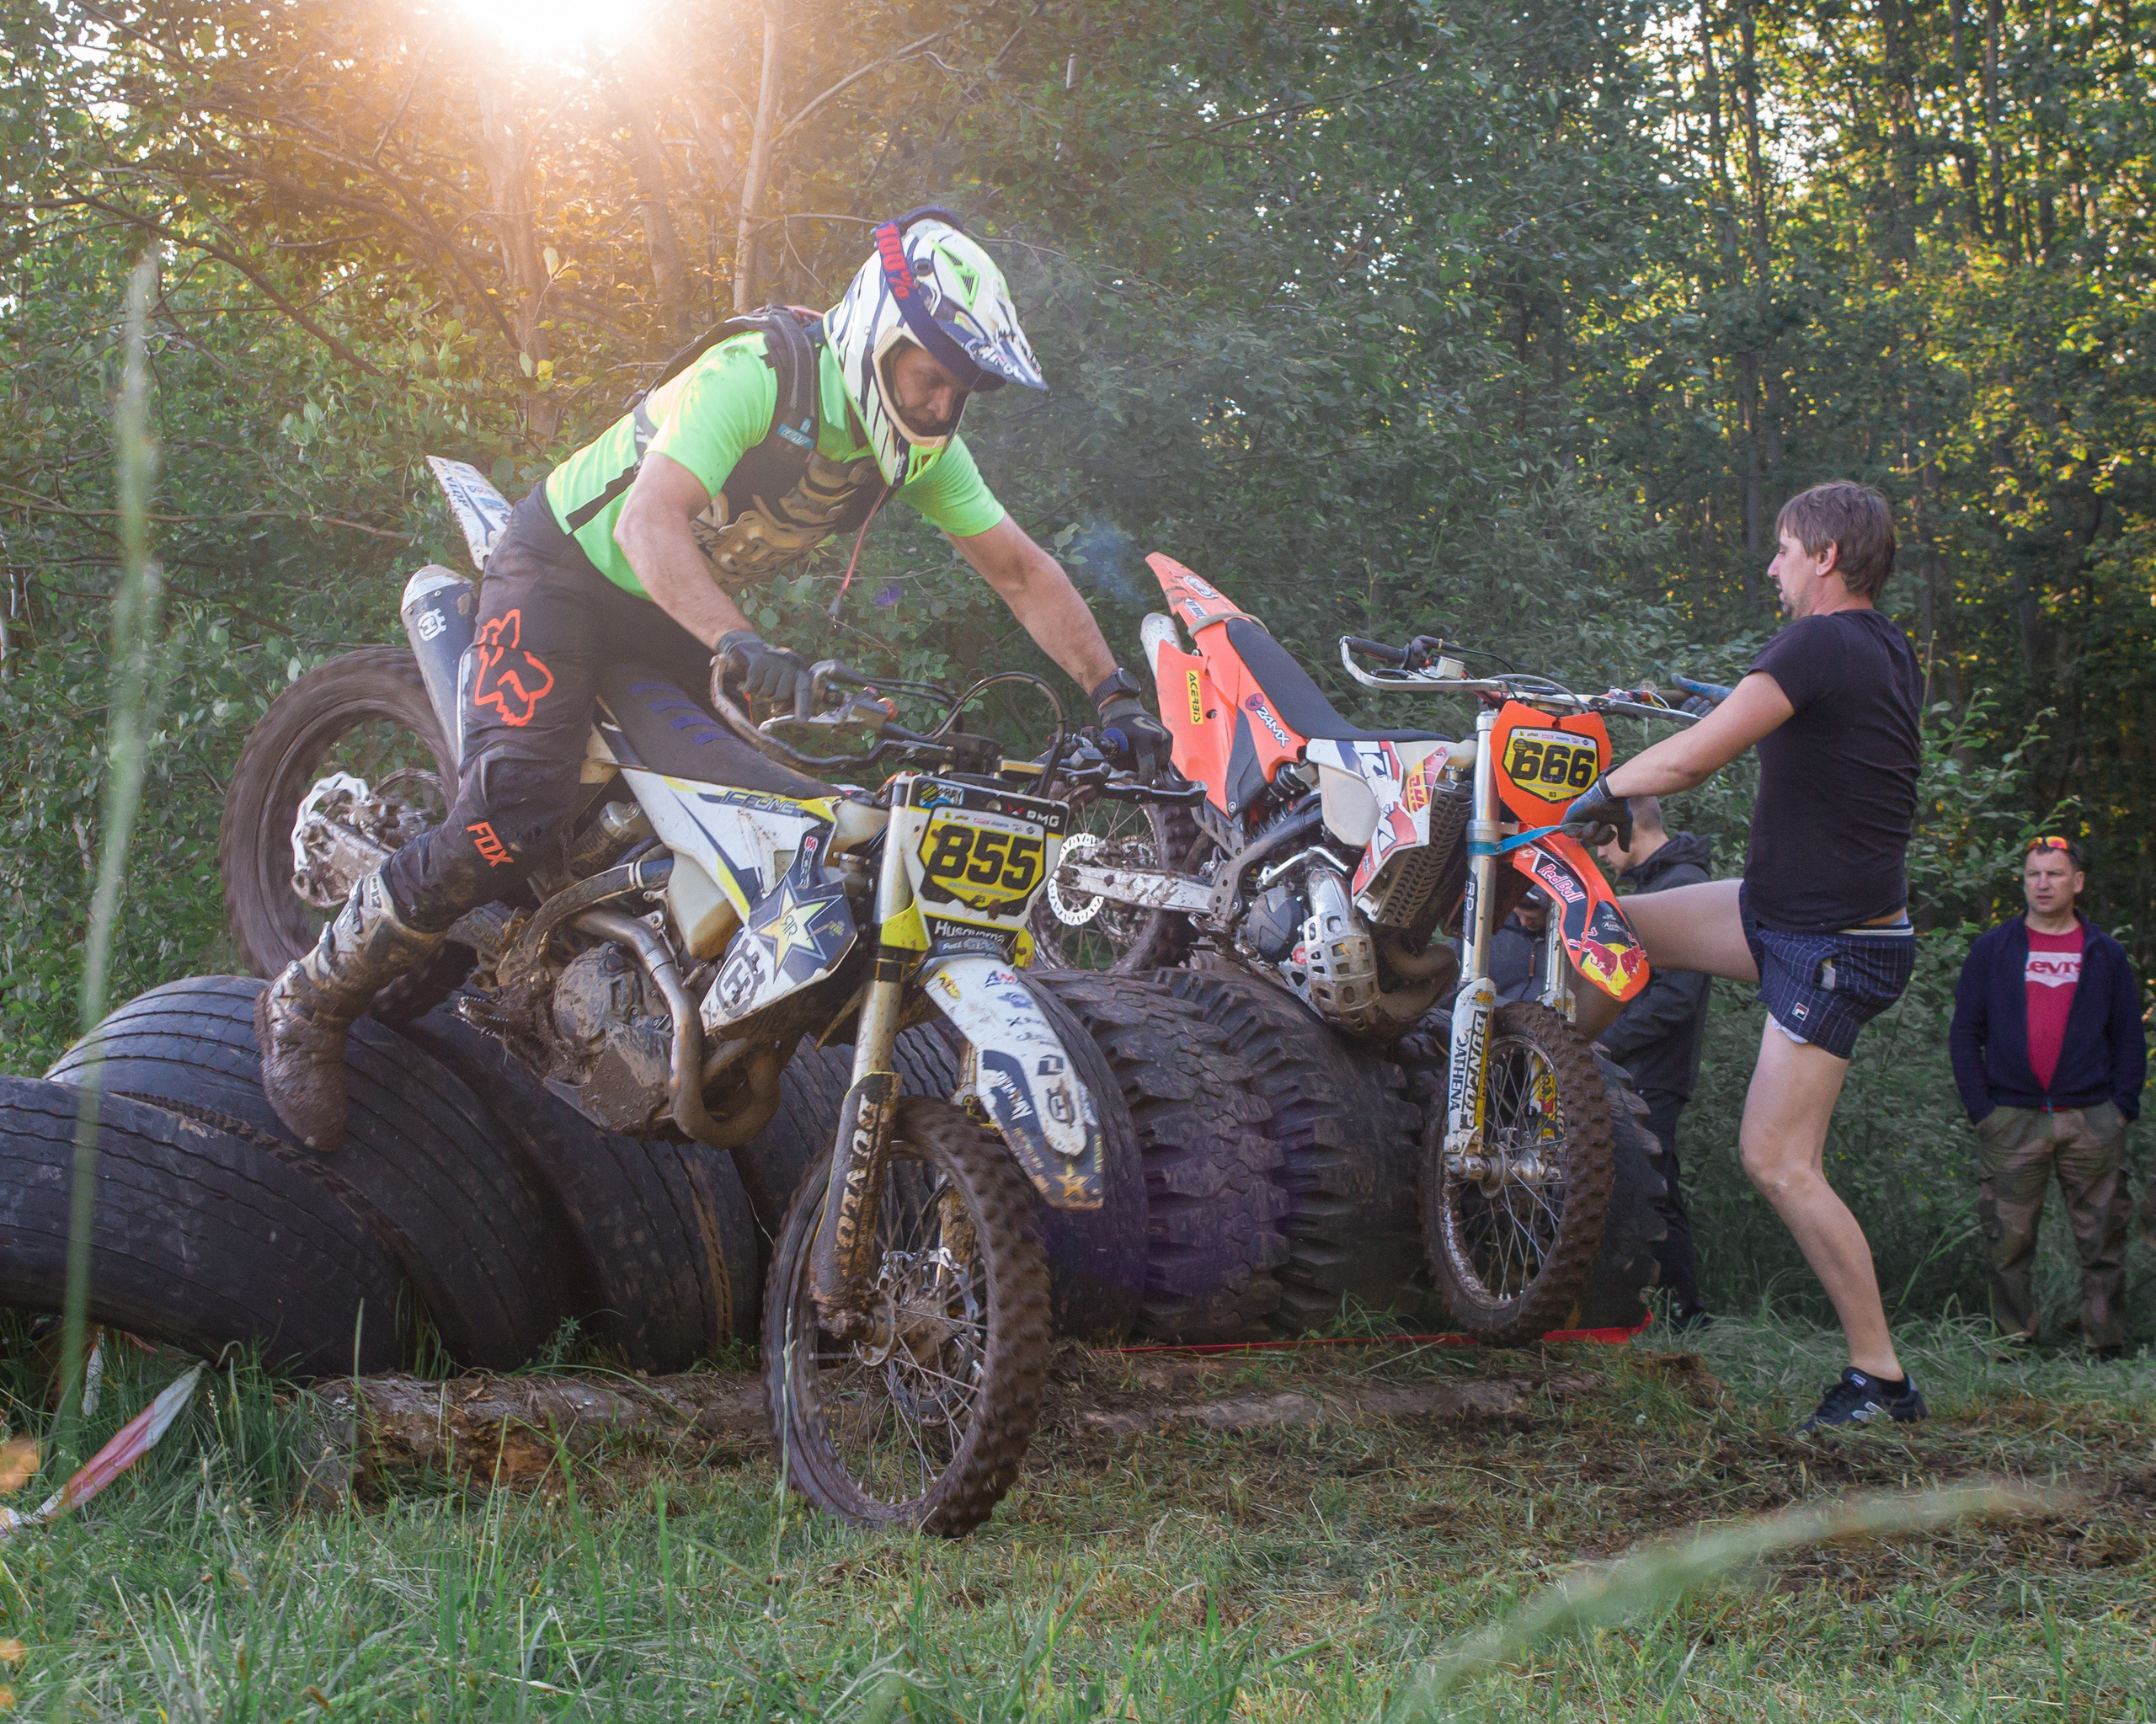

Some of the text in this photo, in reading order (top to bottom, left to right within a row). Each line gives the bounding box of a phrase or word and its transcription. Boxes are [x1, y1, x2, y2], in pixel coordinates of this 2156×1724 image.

[876, 222, 915, 299] 100%
[1255, 705, 1291, 749] 24MX
[1510, 740, 1596, 788] 666
[466, 821, 515, 867] FOX
[926, 824, 1043, 891] 855
[1449, 1047, 1467, 1112] ATHENA
